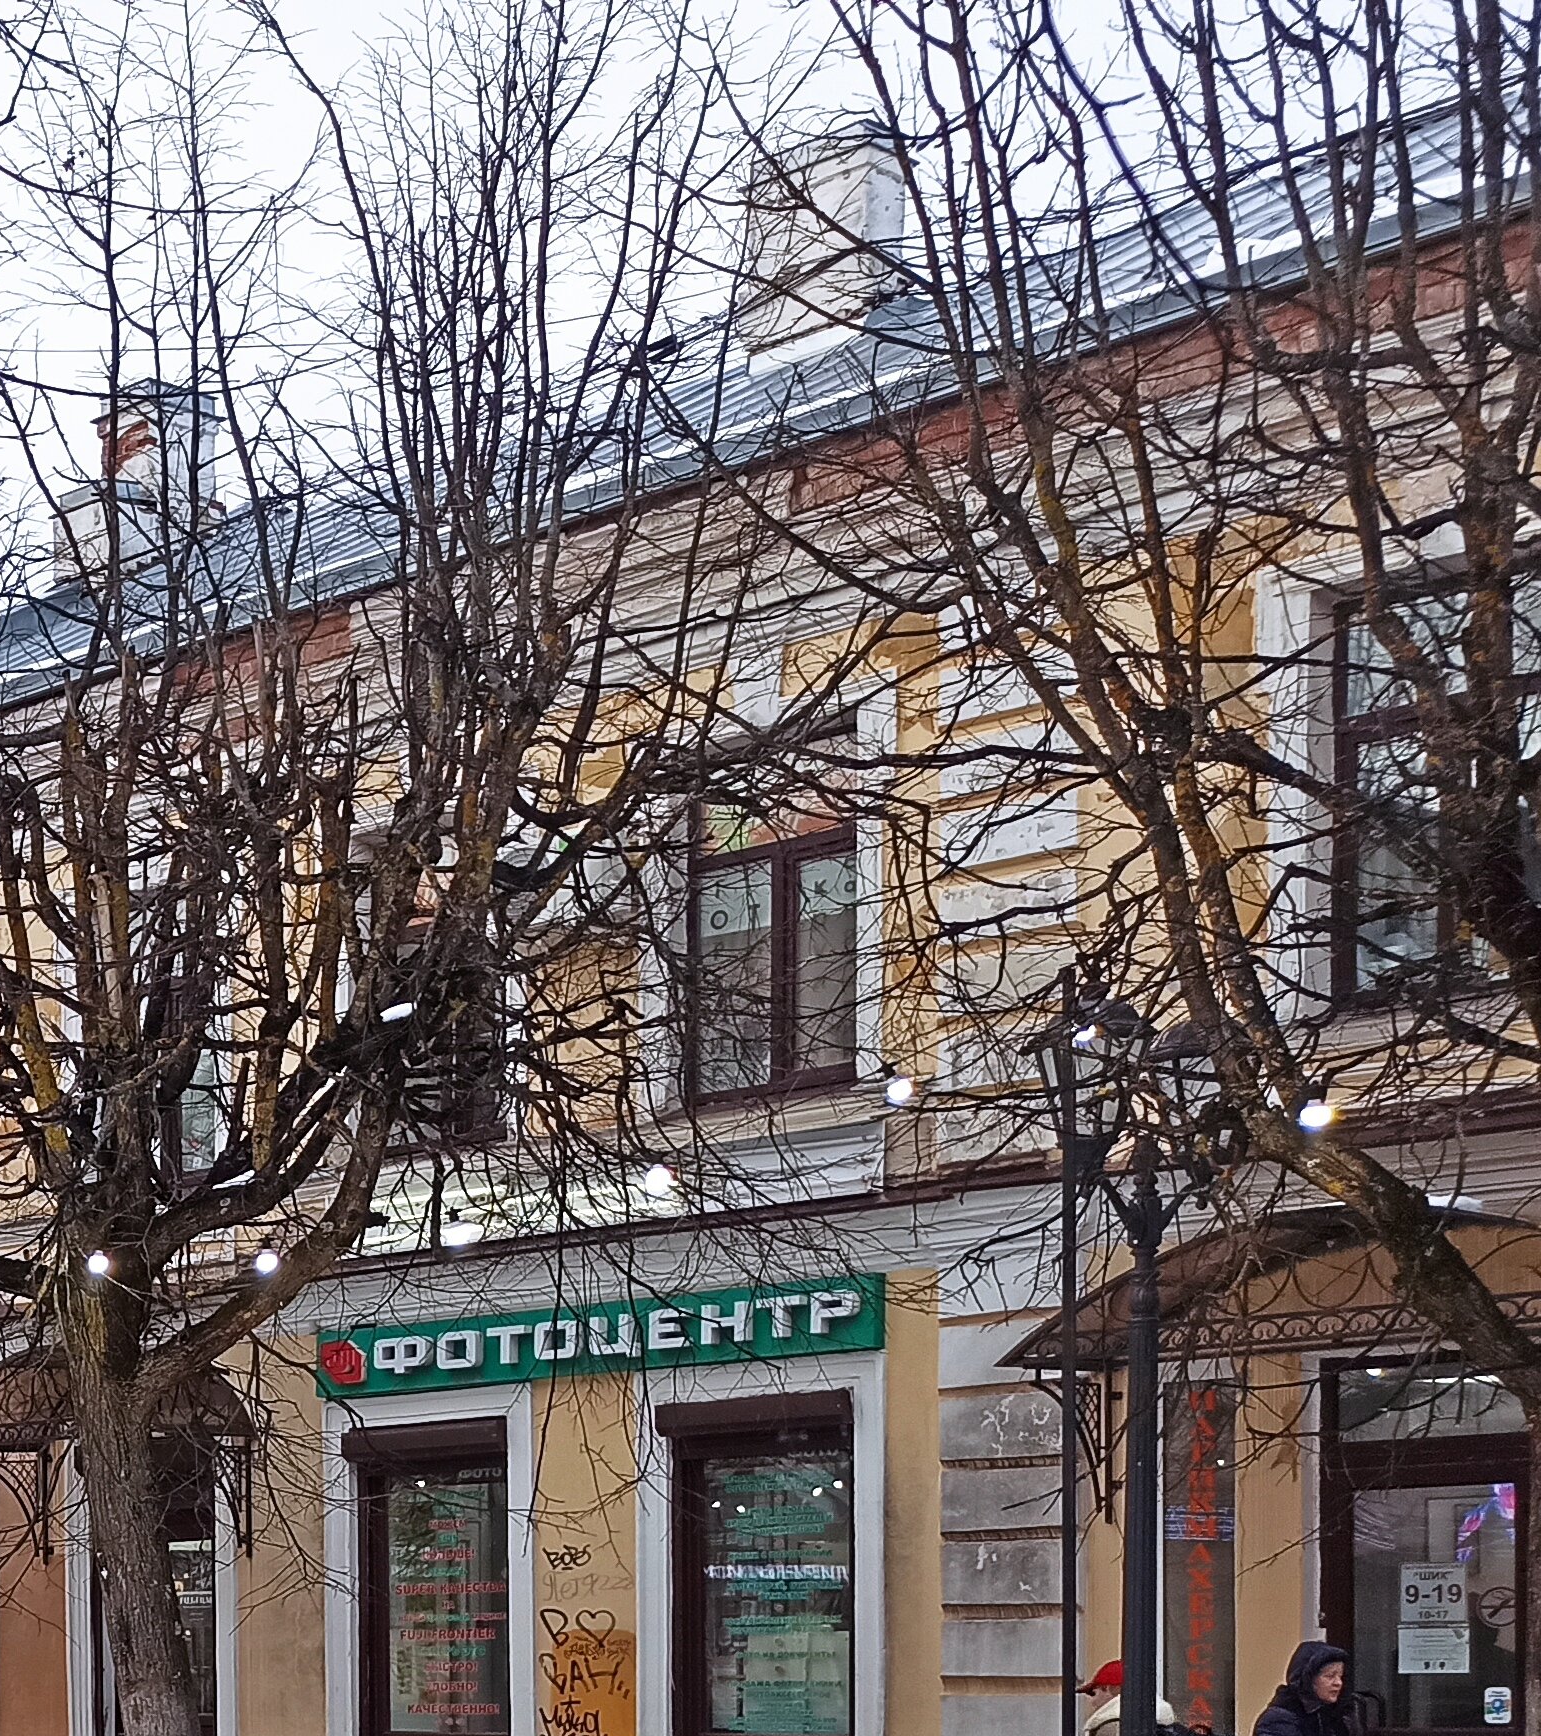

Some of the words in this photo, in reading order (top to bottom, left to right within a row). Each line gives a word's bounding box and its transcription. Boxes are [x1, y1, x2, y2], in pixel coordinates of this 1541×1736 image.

[374, 1289, 861, 1374] ФОТОЦЕНТР
[1404, 1583, 1463, 1604] 9-19
[1418, 1610, 1449, 1619] 10-17
[432, 1628, 497, 1640] FRONTIER
[407, 1704, 500, 1716] КАЧЕСТВЕННО!
